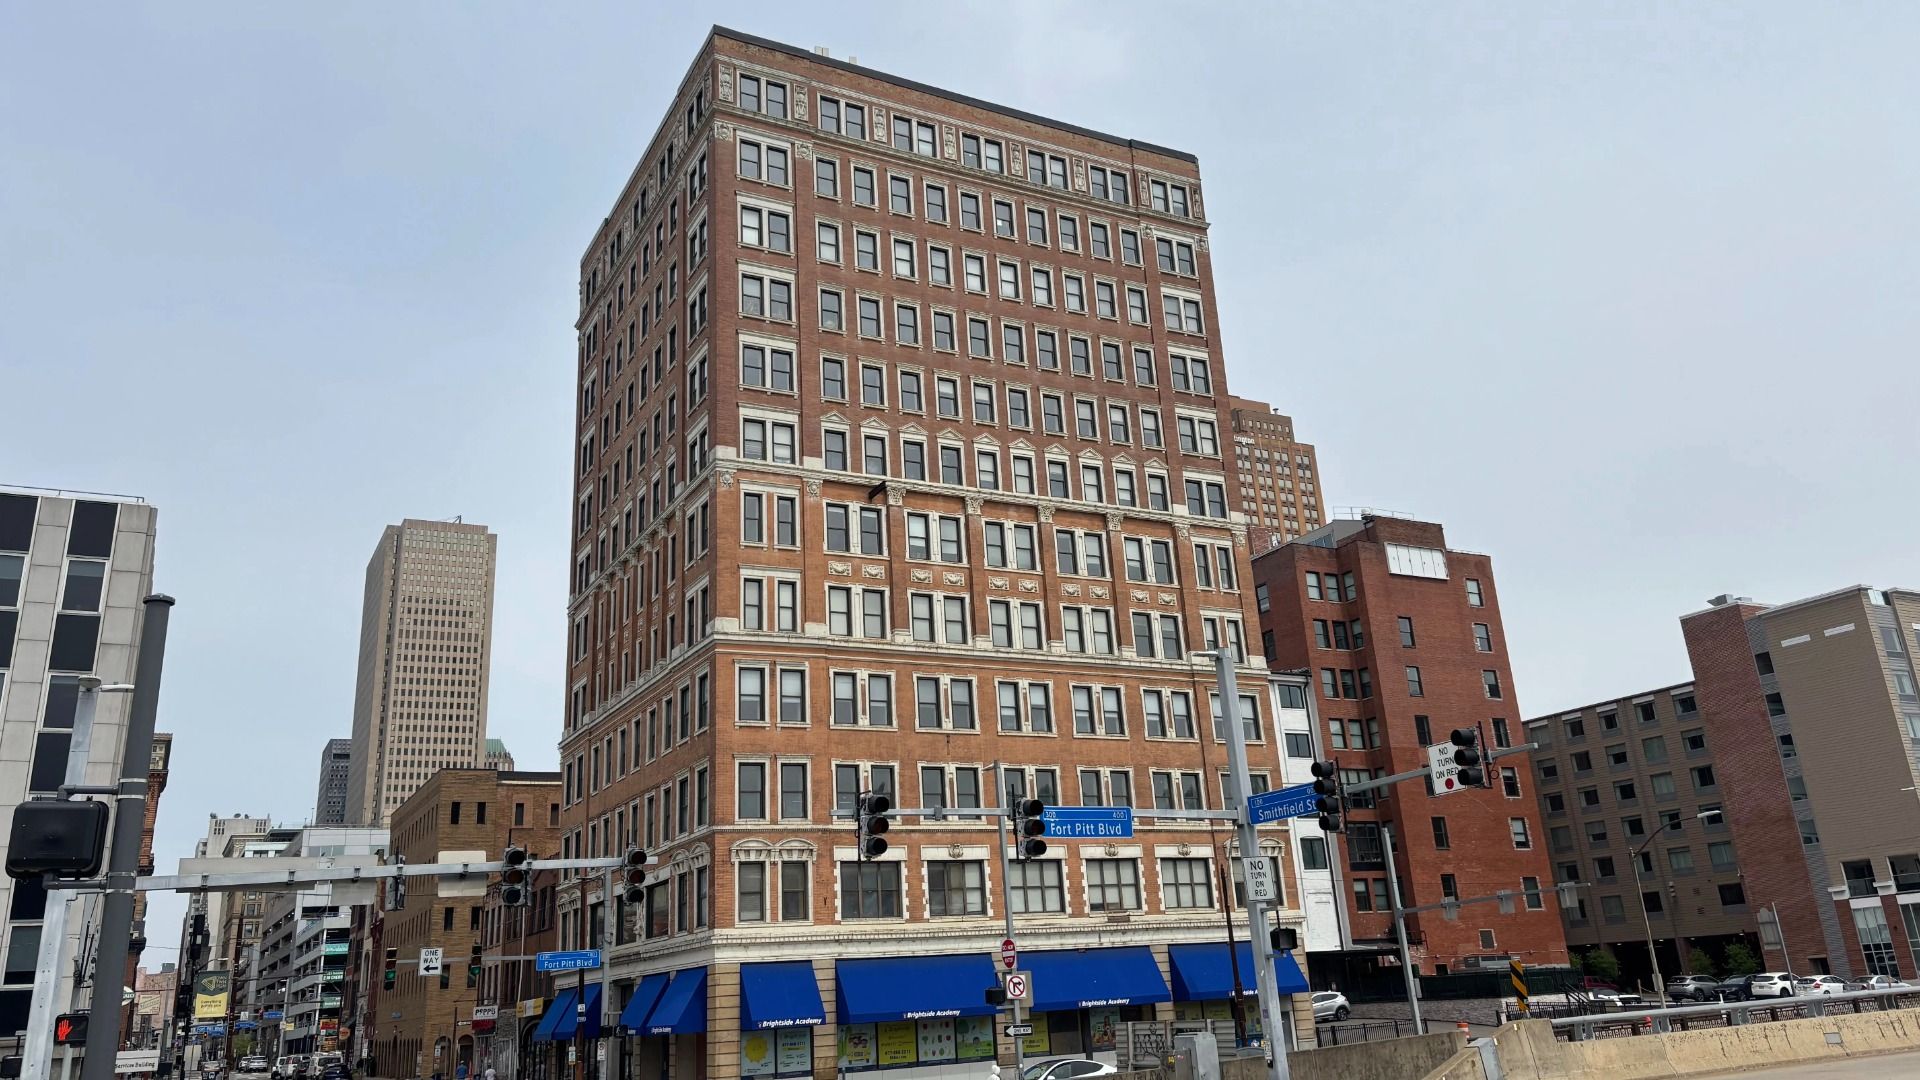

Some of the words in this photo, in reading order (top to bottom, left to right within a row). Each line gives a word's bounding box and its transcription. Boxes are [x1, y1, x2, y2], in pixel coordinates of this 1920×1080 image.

[1438, 746, 1448, 756] NO
[1436, 756, 1455, 767] TURN
[1435, 770, 1445, 779] ON
[1446, 766, 1459, 777] RED
[1258, 802, 1304, 821] Smithfield
[1306, 799, 1317, 811] St
[1045, 811, 1056, 819] 300
[1050, 823, 1072, 835] Fort
[1075, 823, 1095, 835] Pitt
[1098, 823, 1122, 835] Blvd
[1250, 860, 1264, 871] NO
[1250, 871, 1267, 880] TURN
[1255, 880, 1265, 888] ON
[1254, 888, 1268, 897] RED
[424, 949, 439, 957] ONE
[423, 956, 440, 964] WAY
[544, 960, 559, 969] Fort
[561, 960, 575, 968] Pitt
[576, 959, 593, 967] Blvd
[907, 1010, 935, 1019] Brightside
[762, 1019, 793, 1028] Brightside
